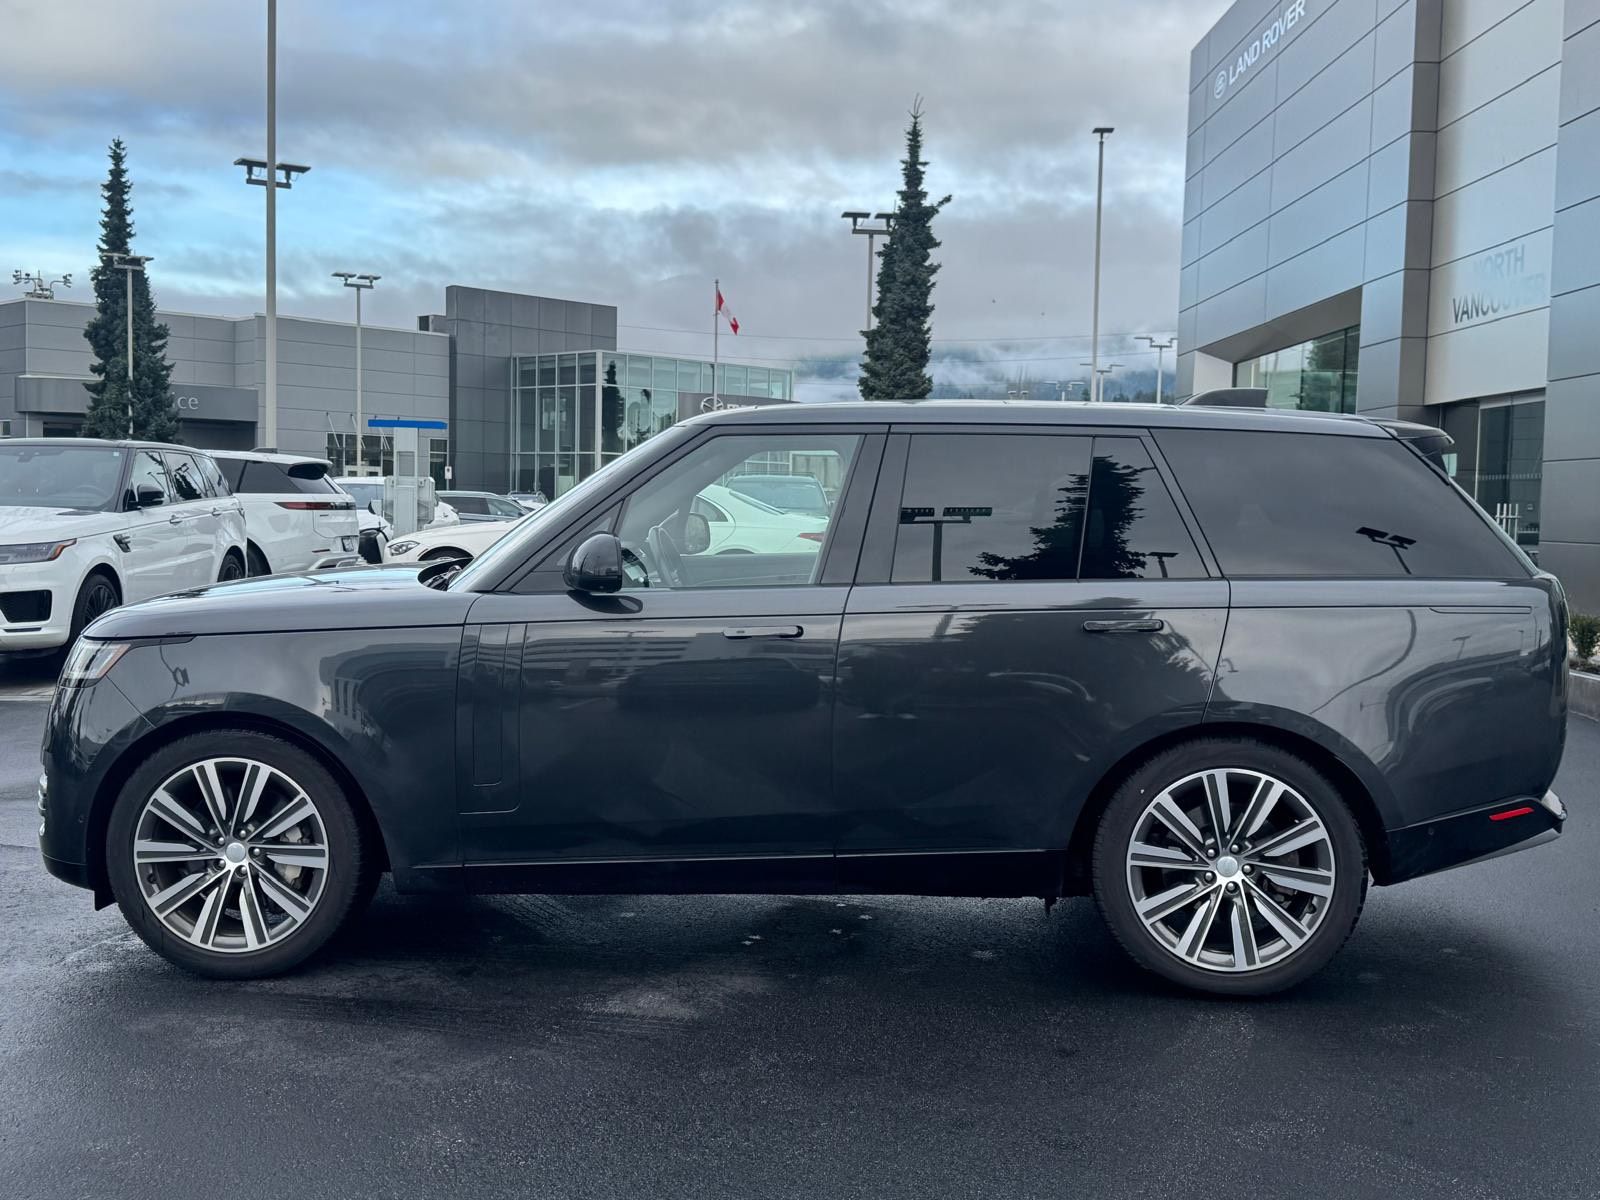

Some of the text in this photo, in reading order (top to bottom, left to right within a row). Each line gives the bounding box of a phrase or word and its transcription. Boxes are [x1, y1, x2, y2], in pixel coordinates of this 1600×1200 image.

[1229, 40, 1260, 85] LAND
[1262, 0, 1306, 53] ROVER
[1452, 271, 1546, 324] VANCOUER
